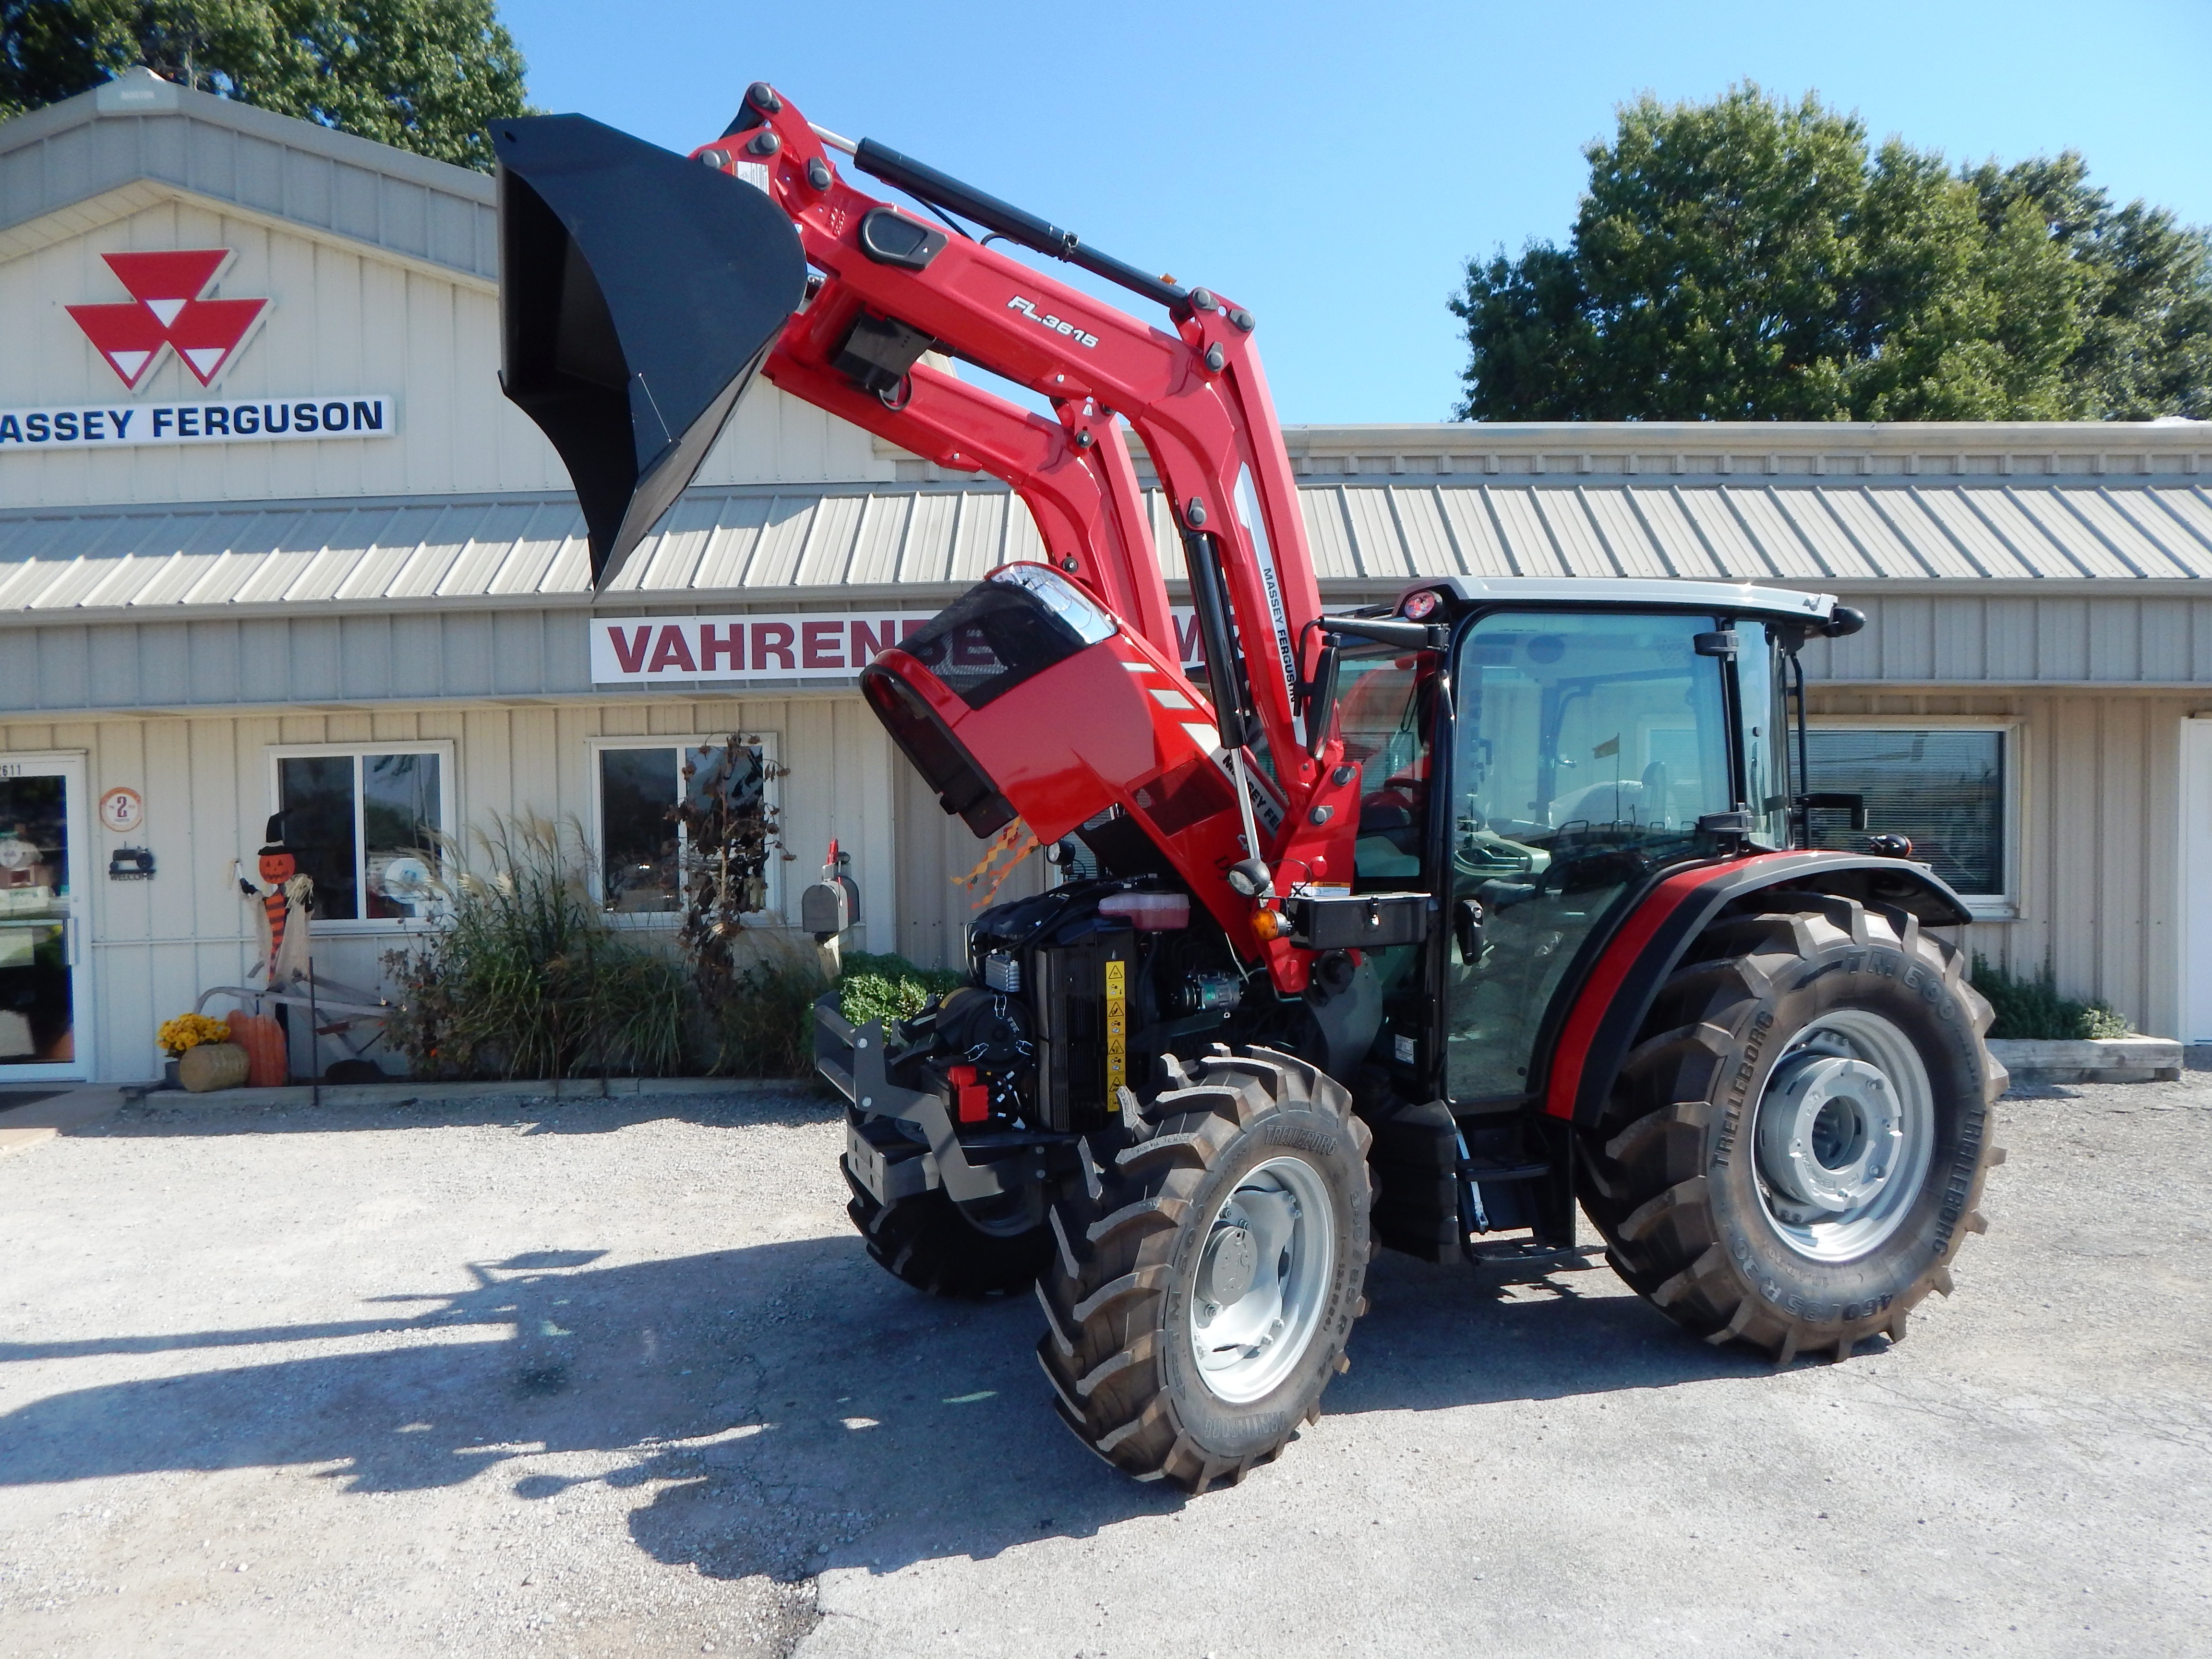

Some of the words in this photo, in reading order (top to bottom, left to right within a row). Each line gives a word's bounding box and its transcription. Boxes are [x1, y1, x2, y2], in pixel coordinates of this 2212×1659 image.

[1007, 295, 1099, 348] FL.3615
[153, 400, 383, 437] FERGUSON
[1263, 567, 1284, 624] MASSEY
[0, 765, 21, 776] 611
[117, 796, 128, 817] 2
[1847, 949, 1899, 977] TM
[1903, 964, 1956, 1020] 600
[1710, 1010, 1774, 1170] TRELLEBORG
[1264, 1124, 1338, 1156] TRELLEBORG
[1932, 1109, 1986, 1257] TRELLEBORG
[1167, 1291, 1182, 1351] TM
[1178, 1204, 1205, 1276] 600
[1203, 1410, 1286, 1439] TRELLEBORG
